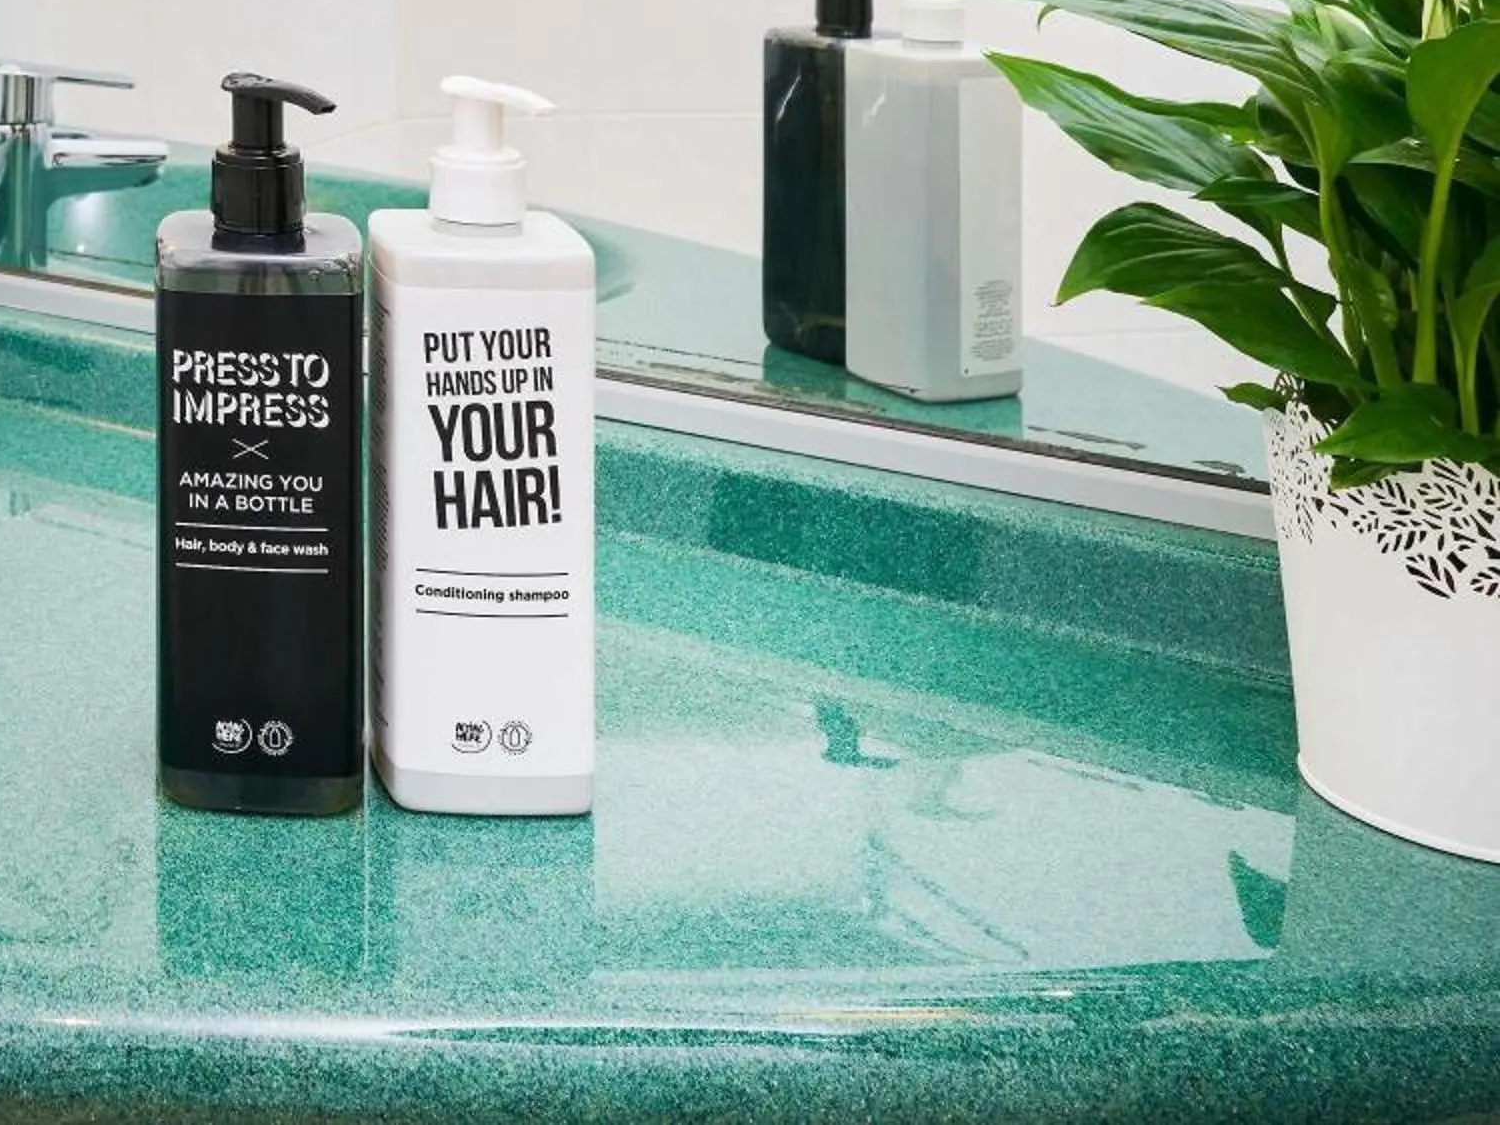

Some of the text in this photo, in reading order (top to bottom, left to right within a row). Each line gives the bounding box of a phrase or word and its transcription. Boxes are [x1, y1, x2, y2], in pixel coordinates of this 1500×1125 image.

[423, 327, 552, 363] PUT YOUR
[172, 348, 329, 388] PRESS TO
[426, 366, 553, 397] HANDS UP IN
[172, 388, 330, 428] IMPRESS
[427, 400, 557, 462] YOUR
[179, 472, 323, 492] AMAZING YOU
[433, 465, 562, 529] HAIR!
[189, 493, 314, 514] IN A BOTTLE
[175, 537, 329, 556] Hair, body & face wash
[415, 584, 570, 603] Conditioning shampoo
